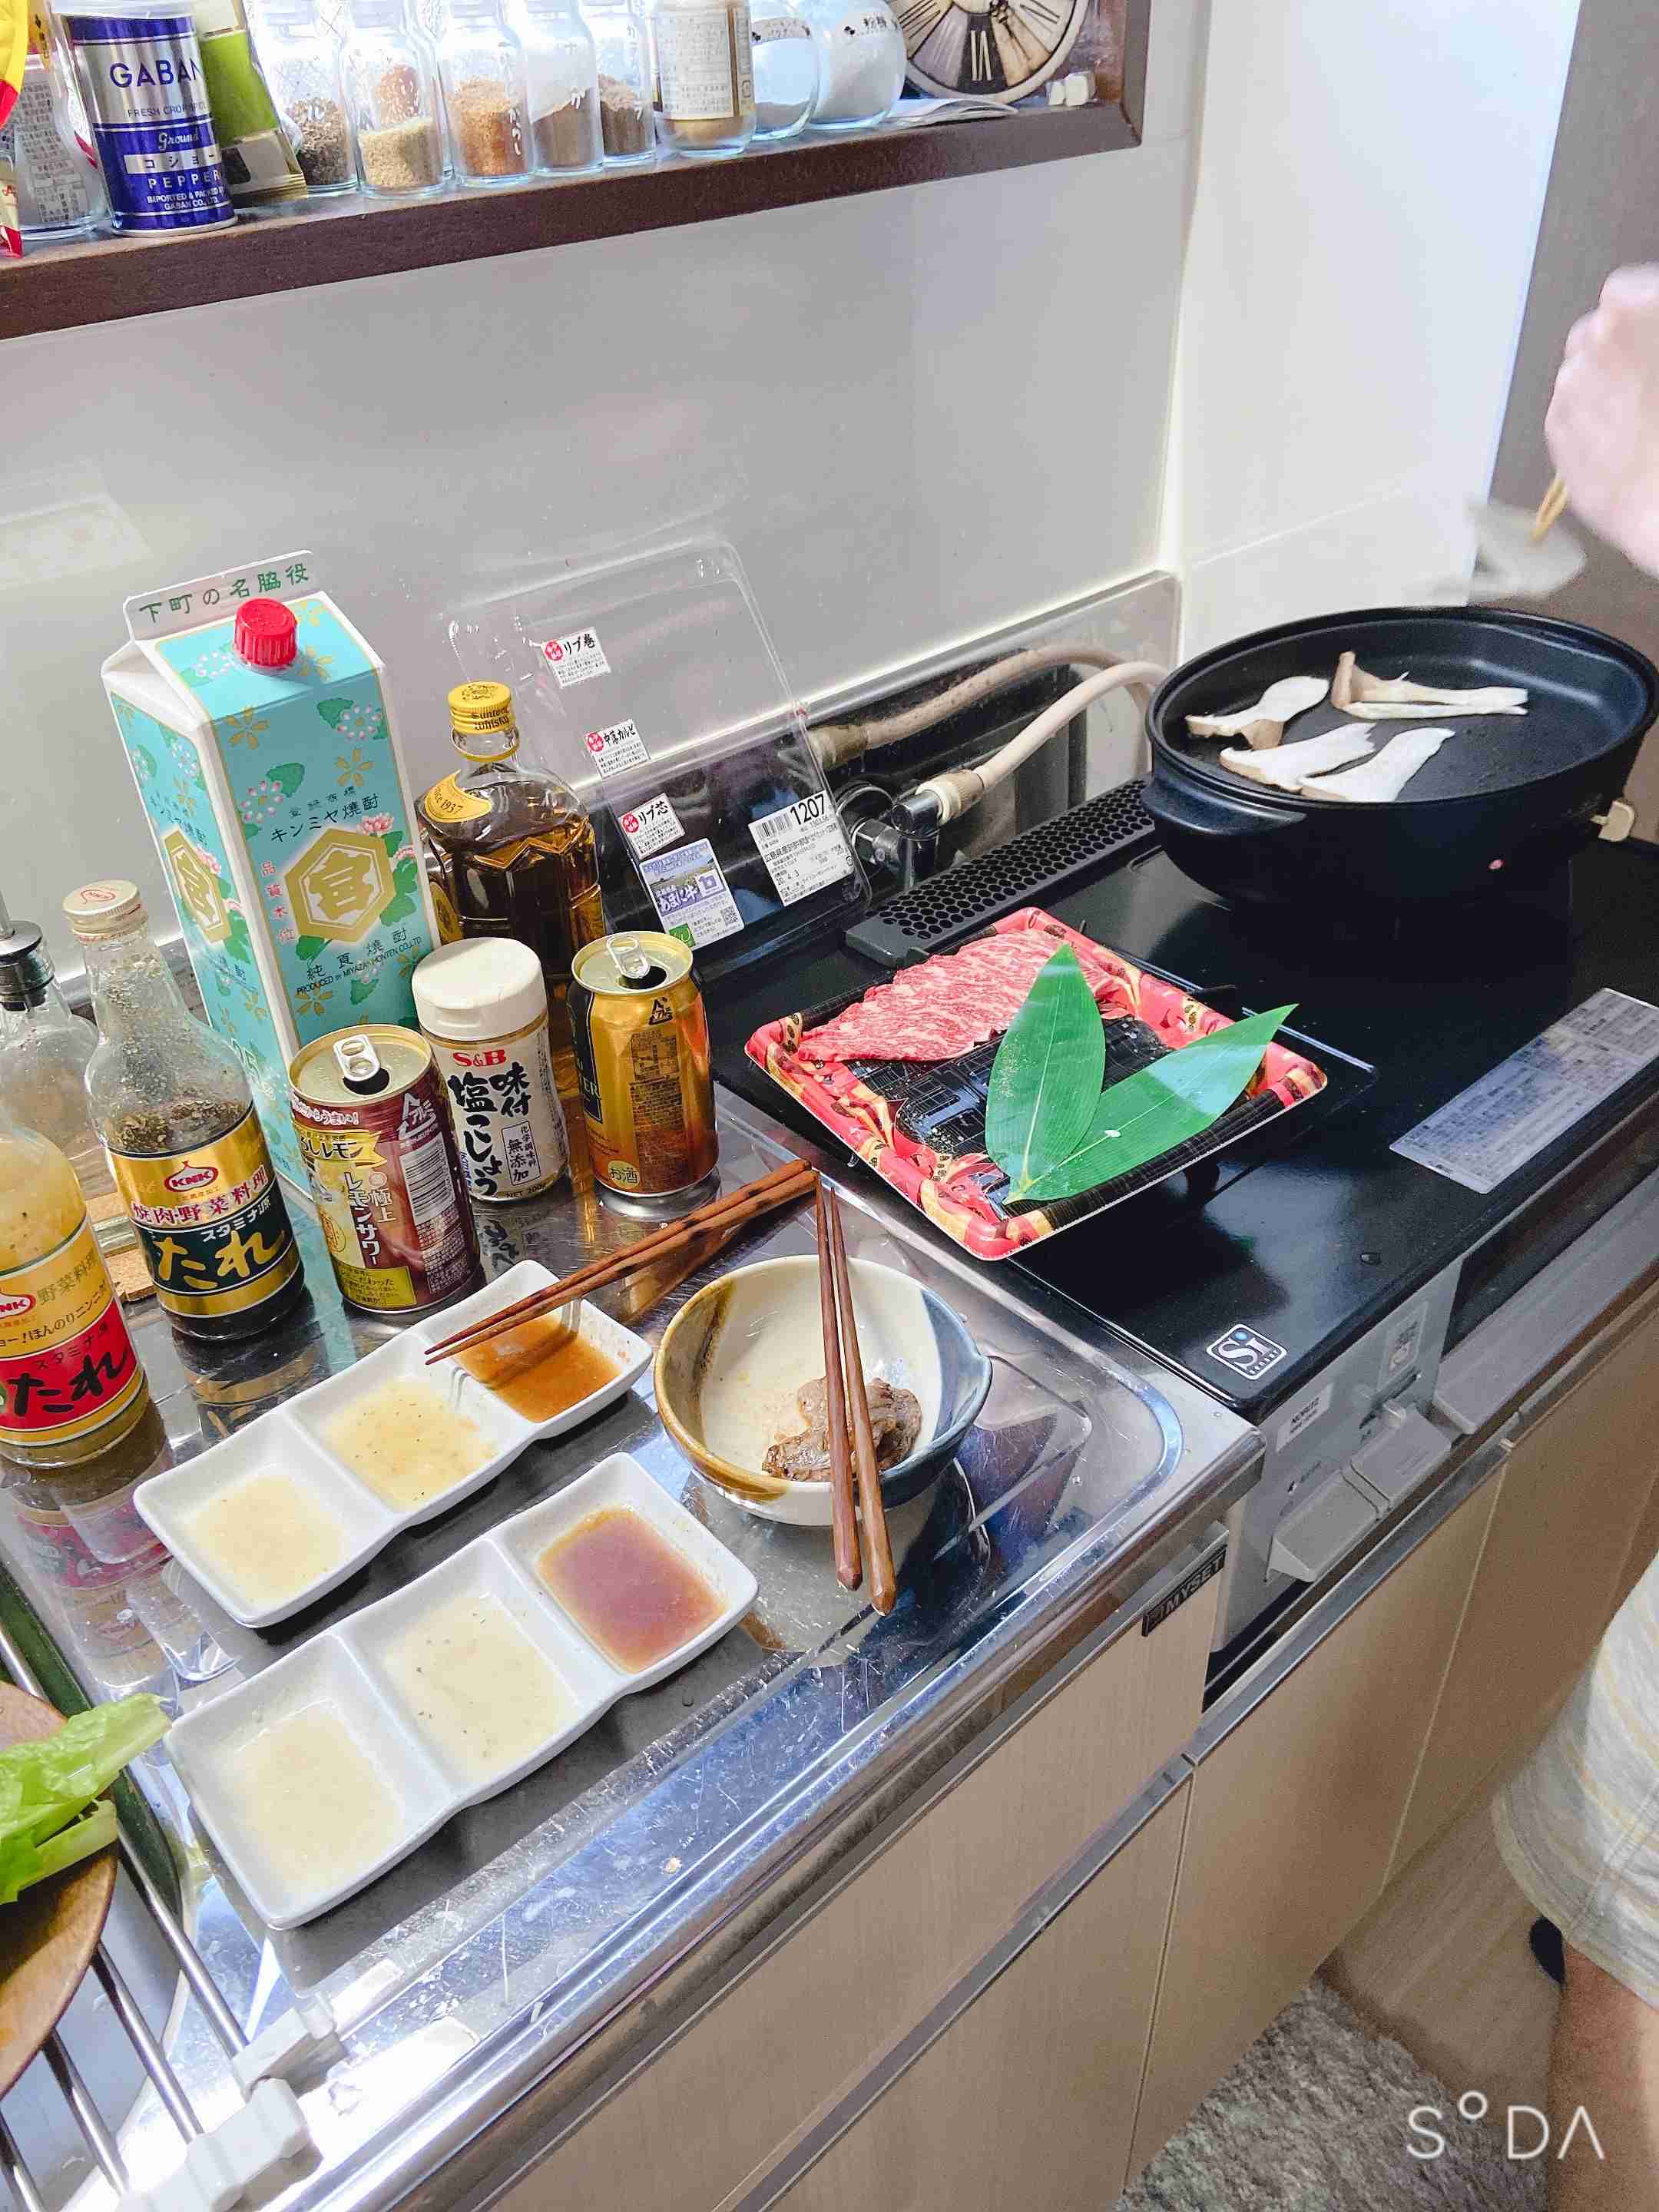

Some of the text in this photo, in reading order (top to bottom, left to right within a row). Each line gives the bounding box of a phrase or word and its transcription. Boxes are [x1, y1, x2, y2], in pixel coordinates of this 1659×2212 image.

[127, 108, 160, 117] FRESH
[158, 132, 200, 151] Ground
[144, 153, 214, 168] コショー
[147, 169, 221, 189] PEPPER
[147, 192, 187, 204] IMPORTED
[164, 200, 192, 210] GABAN
[139, 563, 309, 623] 下町の名脇役
[441, 800, 463, 814] 1937
[639, 800, 669, 824] リブ芯
[790, 793, 825, 826] 1207
[296, 974, 334, 996] PRODUCED
[453, 1049, 507, 1067] S&B
[489, 1061, 531, 1118] 味付
[447, 1072, 504, 1198] 塩こしょう
[507, 1139, 529, 1182] 無添加
[171, 1171, 211, 1187] KNK
[369, 1187, 397, 1223] 極上
[344, 1171, 380, 1265] レモンサワー
[153, 1230, 285, 1290] たれ
[7, 1347, 127, 1417] たれ
